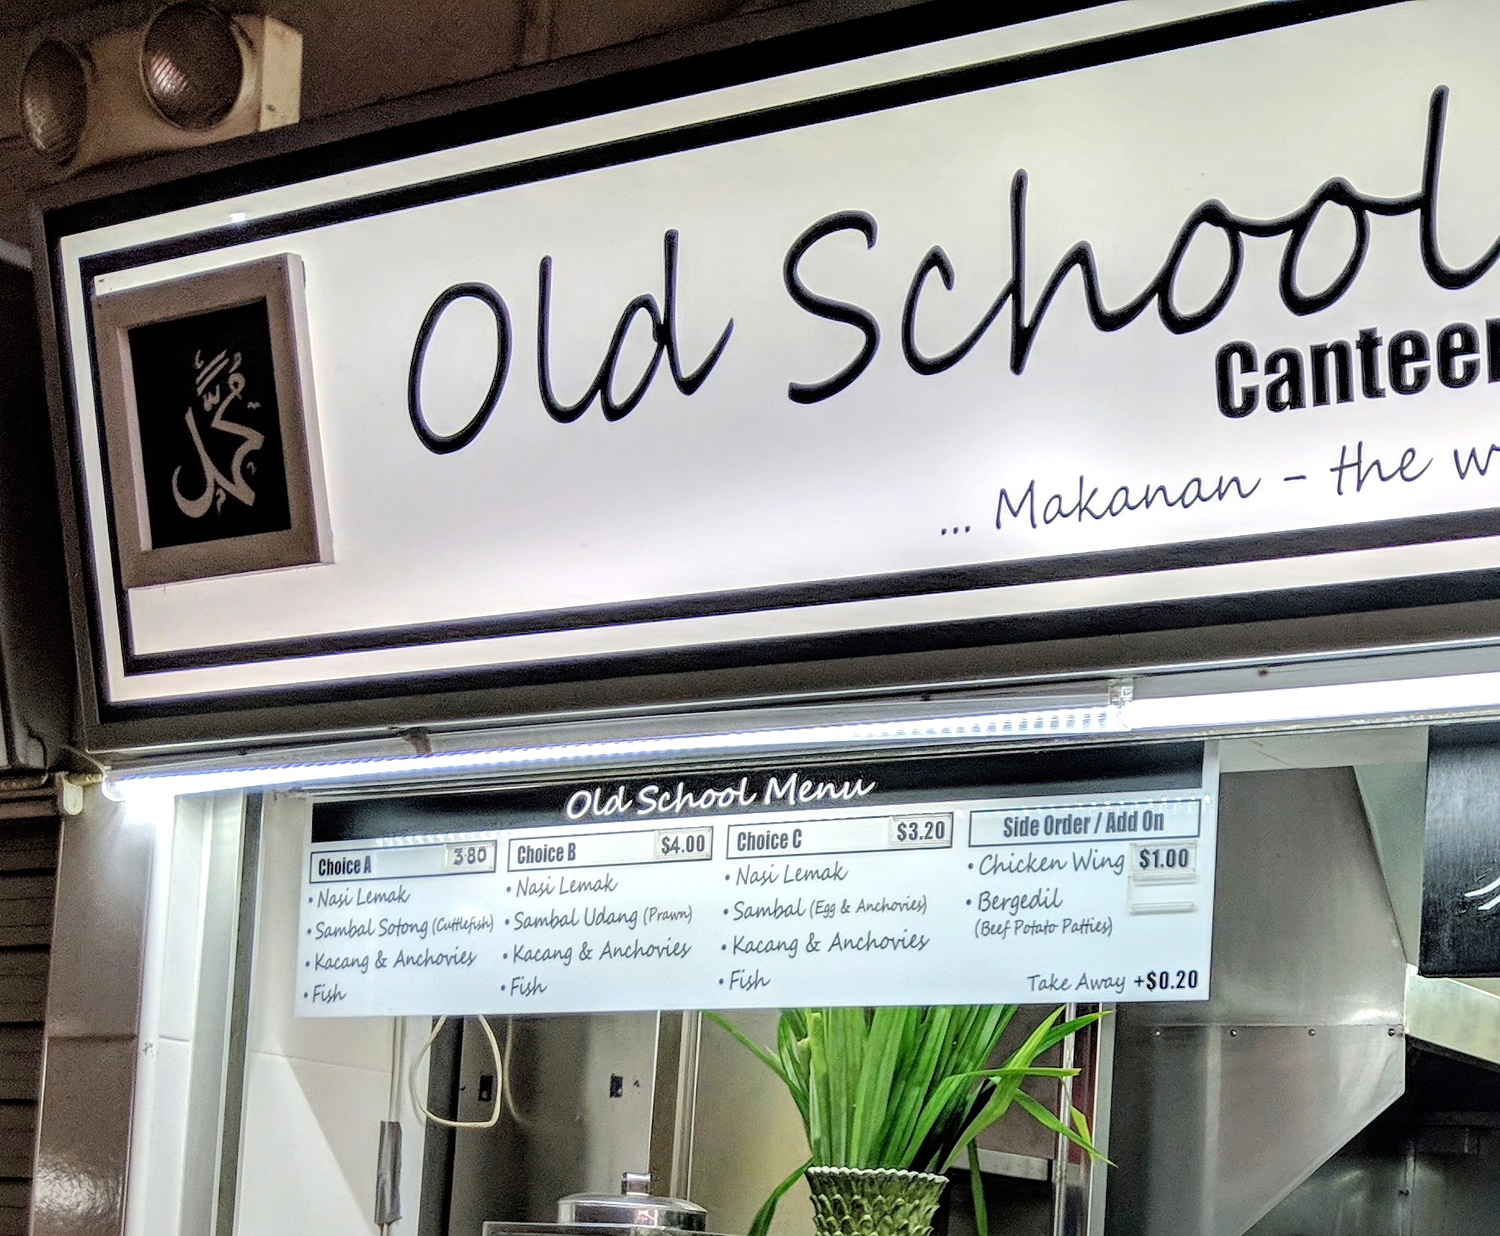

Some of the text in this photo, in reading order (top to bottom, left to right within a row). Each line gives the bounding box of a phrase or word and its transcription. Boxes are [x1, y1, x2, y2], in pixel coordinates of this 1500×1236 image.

[407, 229, 735, 455] Old
[995, 467, 1263, 531] Makanan
[1330, 439, 1434, 497] the
[566, 773, 876, 820] Old School Menu
[897, 821, 945, 842] $3.20
[1003, 810, 1165, 838] Side Order / Add On
[661, 835, 705, 855] $4.00
[737, 828, 803, 851] Choice C
[517, 842, 577, 863] Choice B
[978, 849, 1126, 876] Chicken Wing
[1139, 848, 1190, 869] $1.00
[318, 858, 372, 876] Choice A
[735, 861, 849, 886] Nasi Lemak
[317, 885, 411, 908] Nasi Lemak
[515, 873, 619, 897] Nasi Lemak
[733, 895, 928, 921] Sambal (Egg & Anchovies)
[977, 887, 1064, 914] Bergedil
[315, 913, 494, 939] Sambal Sotong (Cuttlefish)
[513, 905, 693, 930] Sambal Udang (Prawn)
[974, 915, 1113, 939] (Beef Potato Patties)
[513, 939, 692, 967] Kacang & Anchovies
[732, 930, 931, 958] Kacang & Anchovies
[314, 947, 477, 975] Kacang & Anchovies
[510, 978, 549, 997] Fish
[728, 969, 771, 990] Fish
[1028, 974, 1072, 994] Take
[1075, 973, 1126, 996] Away
[312, 983, 347, 1003] Fish
